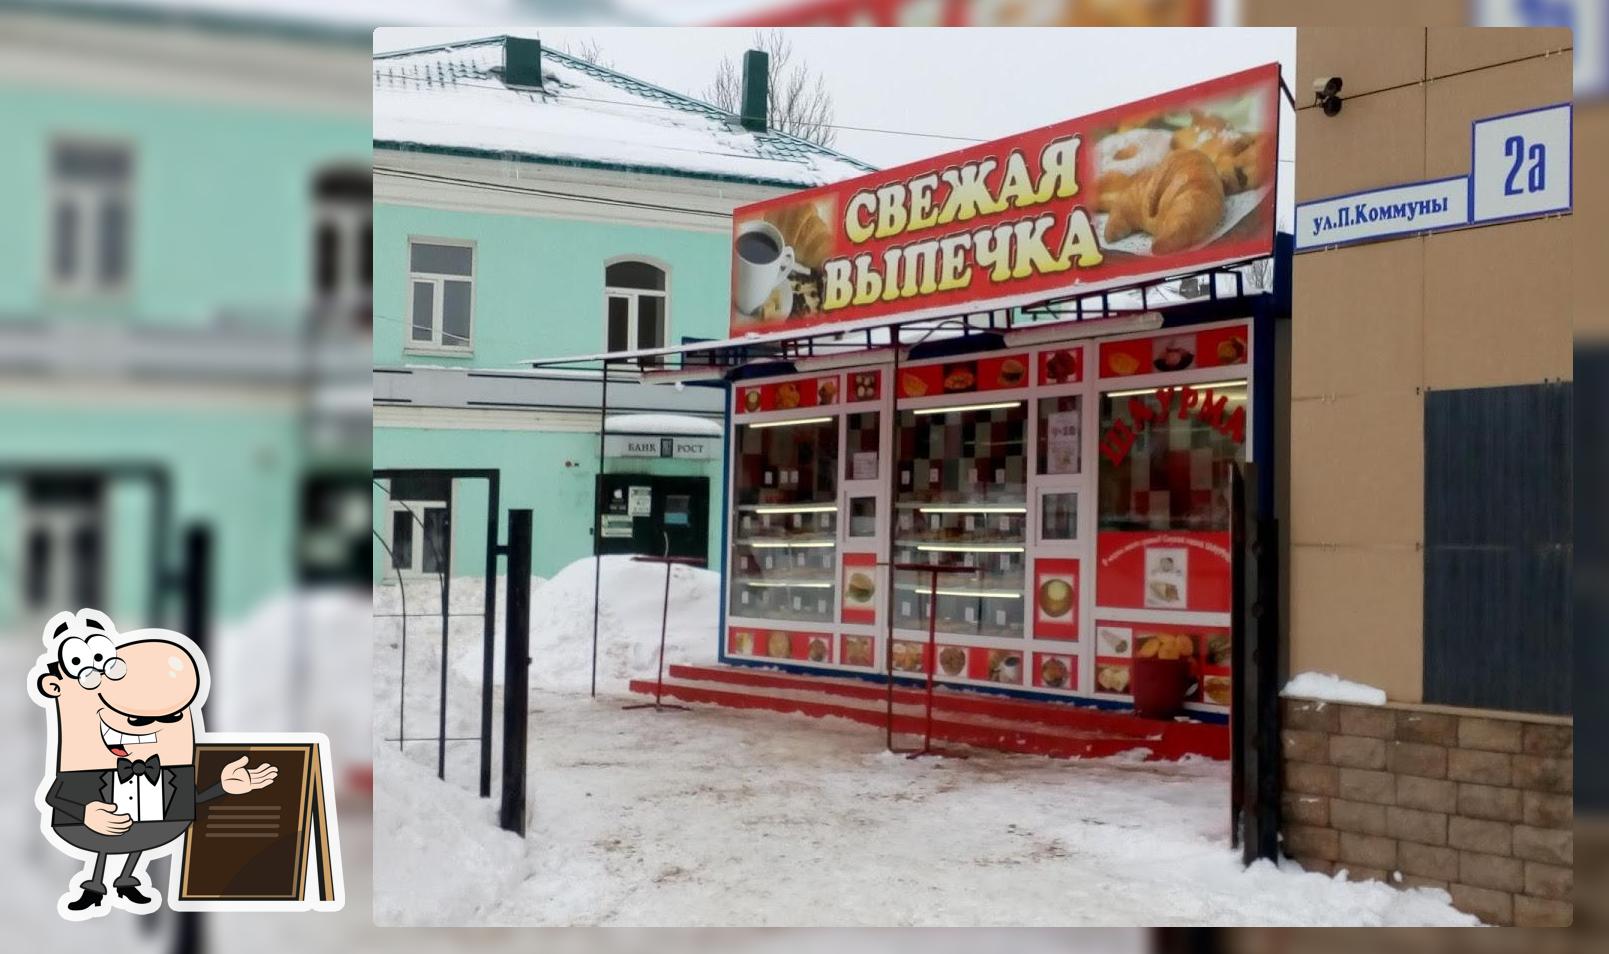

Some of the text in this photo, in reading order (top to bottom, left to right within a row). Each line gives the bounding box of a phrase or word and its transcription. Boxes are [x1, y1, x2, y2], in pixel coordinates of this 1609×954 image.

[844, 133, 1082, 244] СВЕЖАЯ
[1503, 135, 1546, 197] 2а
[1312, 196, 1448, 236] ул.П.Коммуны
[822, 205, 1104, 311] ВЫПЕЧКА
[627, 441, 704, 454] БАНК РОСТ
[1099, 385, 1247, 467] ШАУРМА
